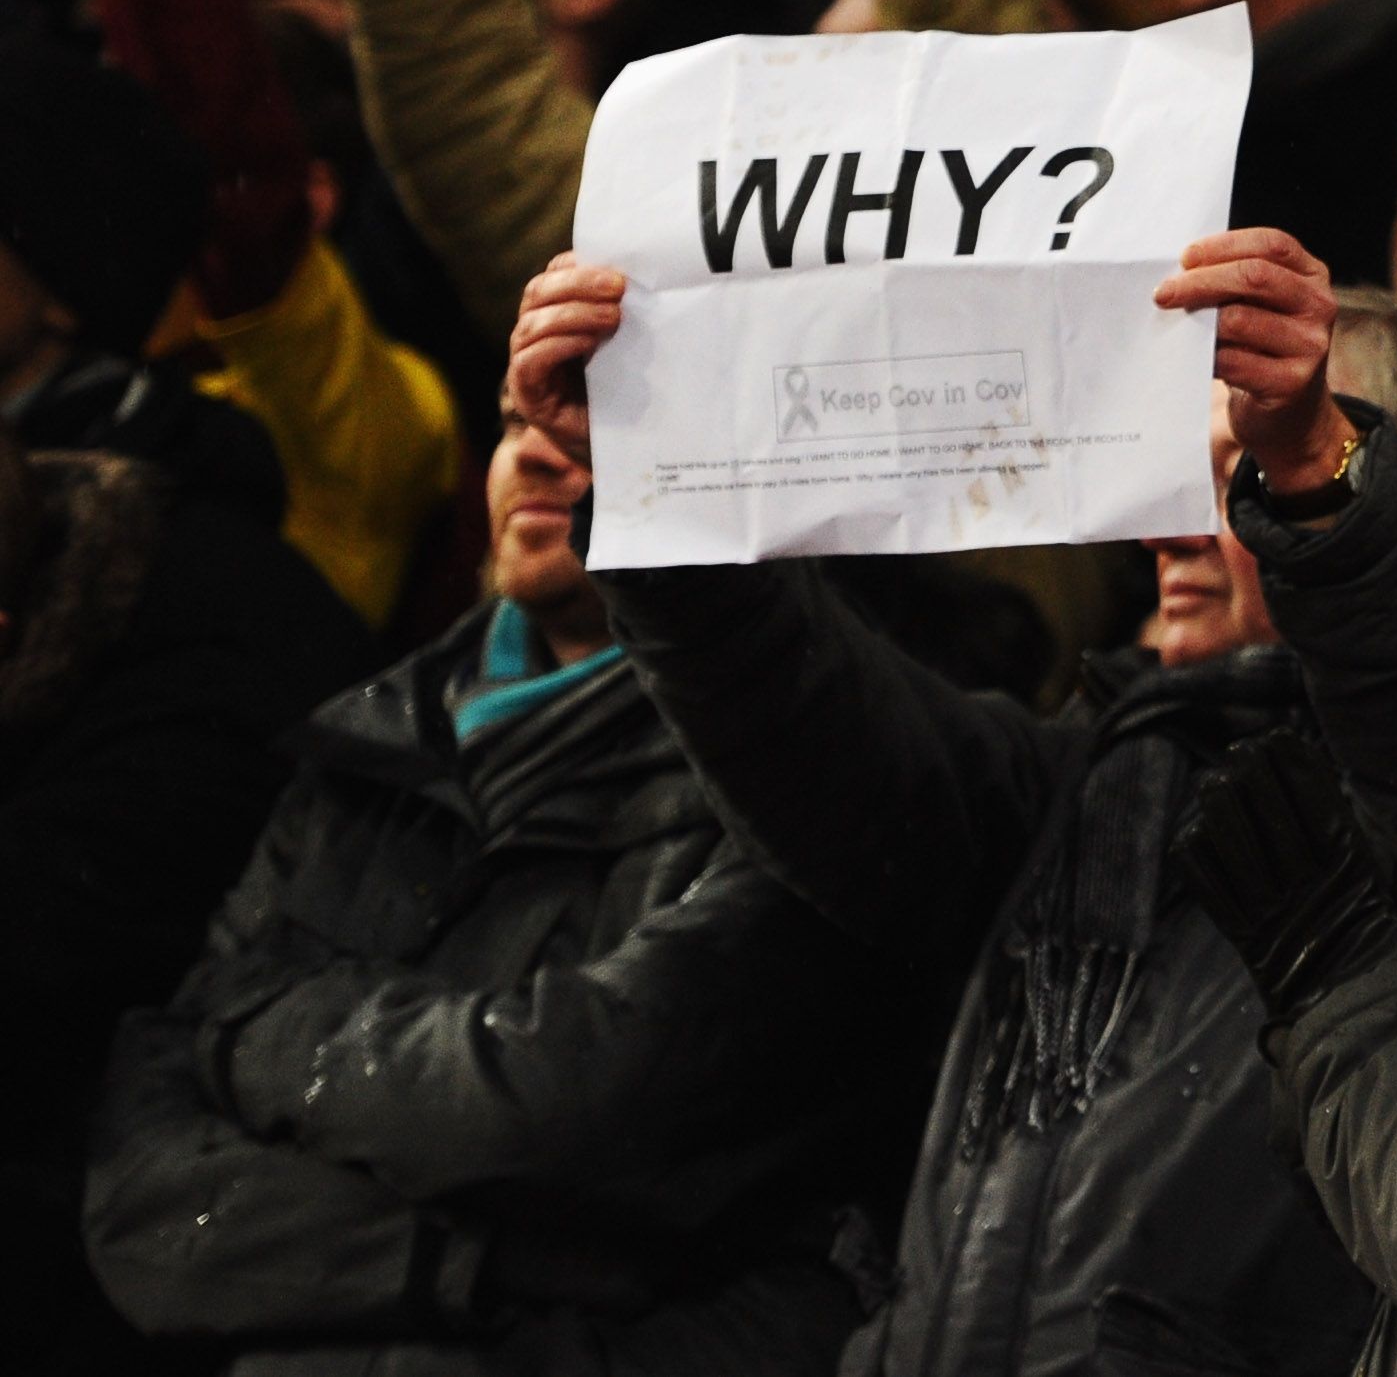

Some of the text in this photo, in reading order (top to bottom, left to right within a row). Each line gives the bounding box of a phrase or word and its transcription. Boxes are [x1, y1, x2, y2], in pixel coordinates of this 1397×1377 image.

[699, 145, 1114, 276] WHY?
[821, 379, 1023, 414] Keep Cov in Cov
